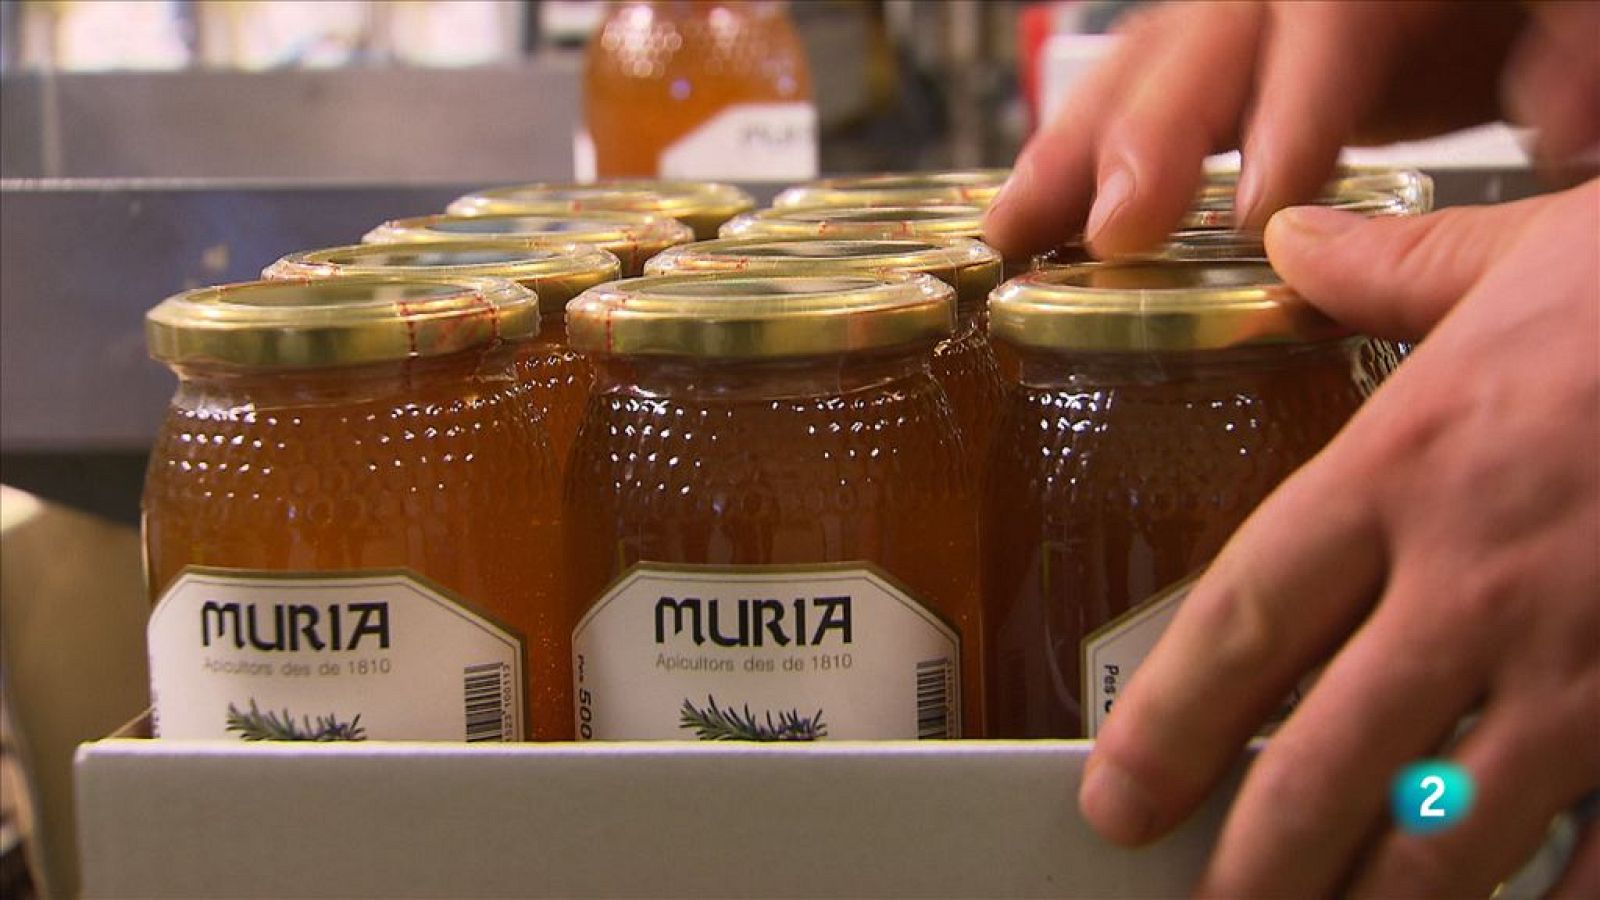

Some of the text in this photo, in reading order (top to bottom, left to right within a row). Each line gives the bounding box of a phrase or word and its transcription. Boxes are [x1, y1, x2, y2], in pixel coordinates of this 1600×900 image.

[201, 601, 390, 651] MURIA
[654, 596, 852, 647] MURIA
[203, 657, 392, 676] Apicultors des de 1810
[655, 652, 853, 673] Apicultors des de 1810
[579, 688, 593, 740] 500
